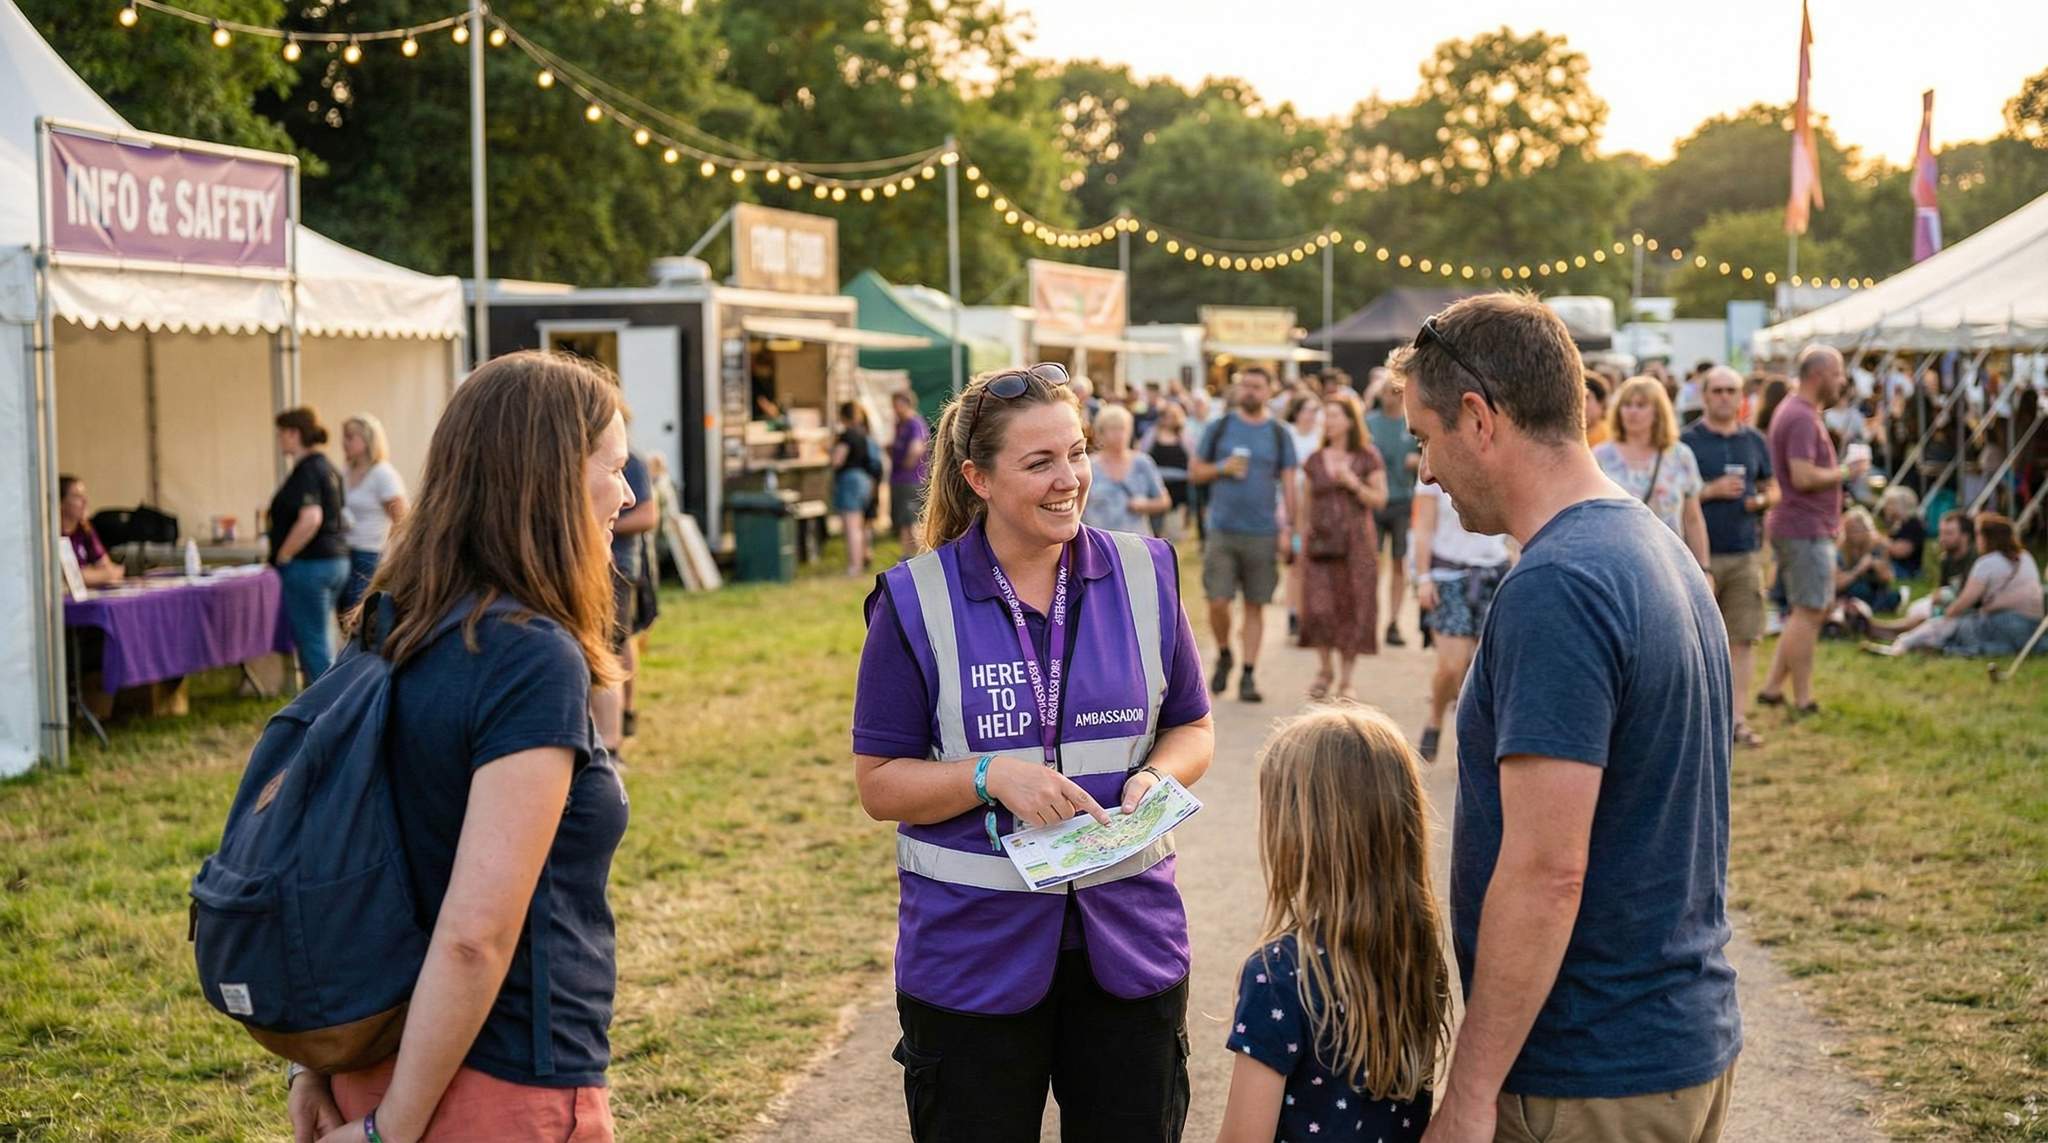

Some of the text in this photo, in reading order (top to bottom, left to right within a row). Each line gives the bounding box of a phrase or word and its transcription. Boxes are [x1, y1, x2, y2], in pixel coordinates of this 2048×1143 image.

[66, 164, 275, 244] INFO & SAFETY
[971, 661, 1027, 688] HERE
[987, 687, 1017, 711] TO
[977, 712, 1032, 739] HELP
